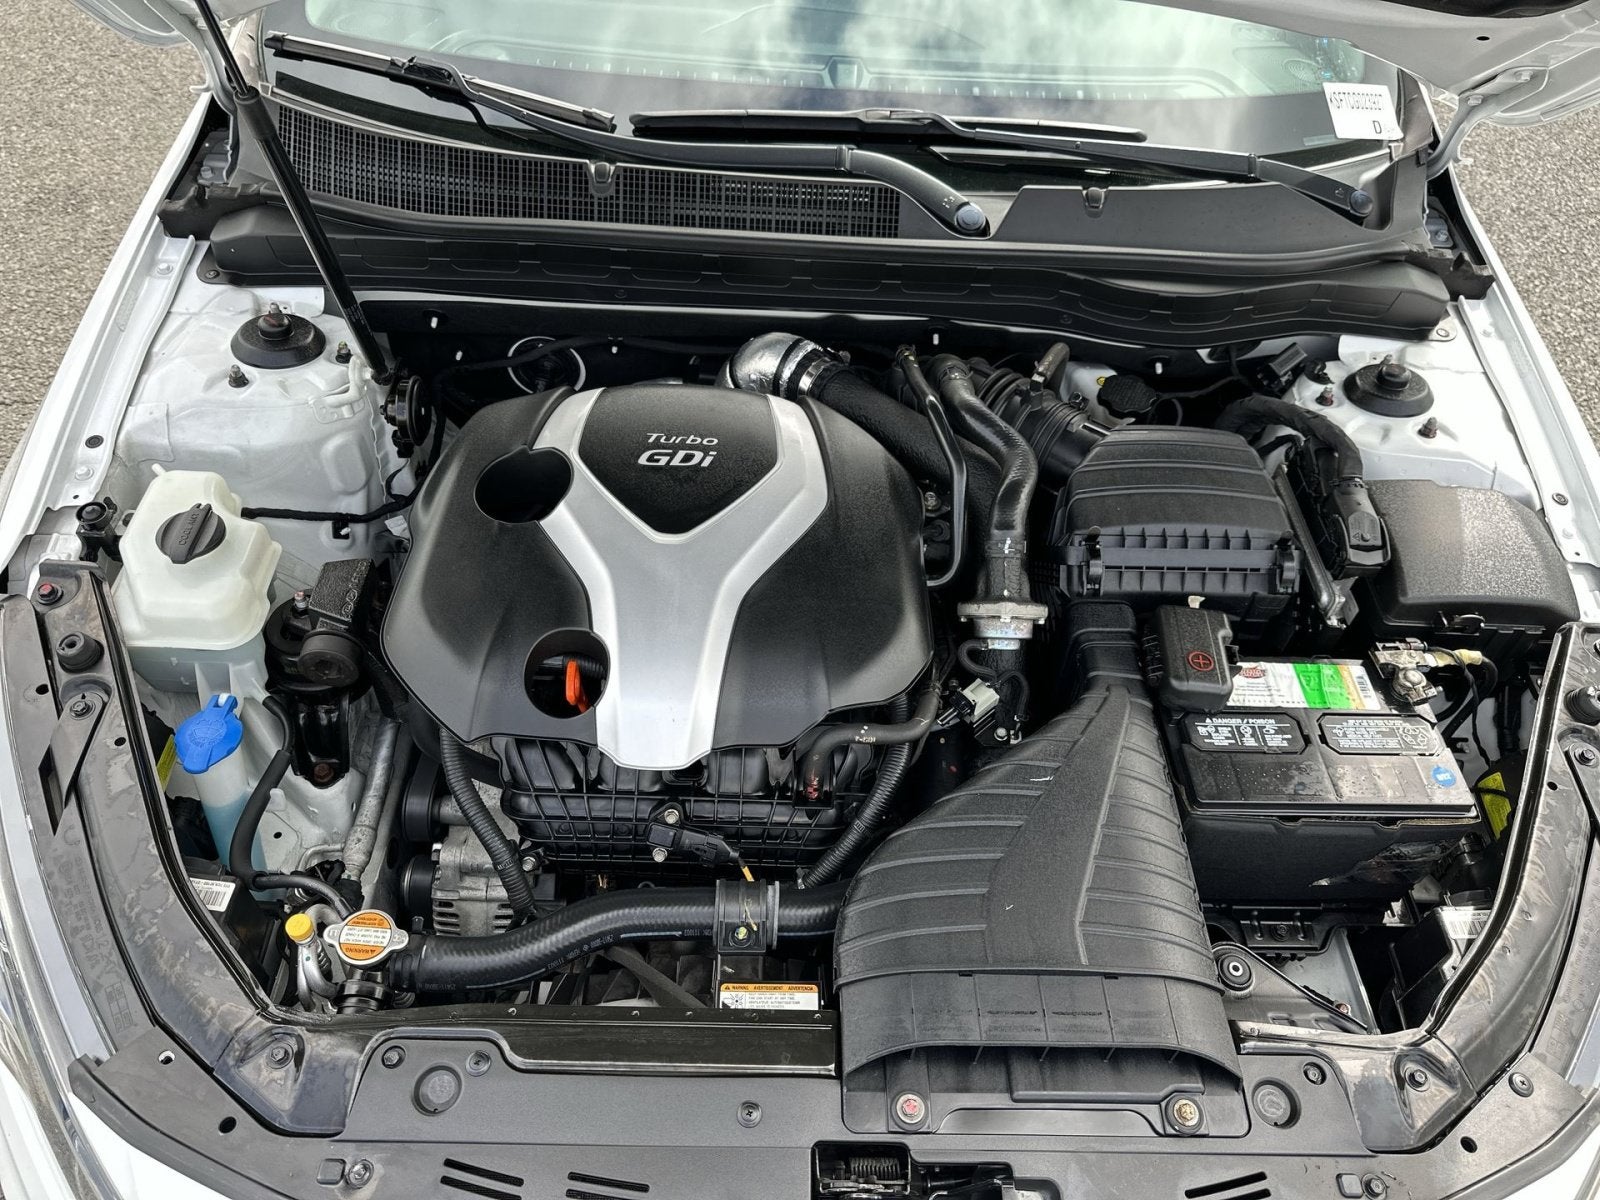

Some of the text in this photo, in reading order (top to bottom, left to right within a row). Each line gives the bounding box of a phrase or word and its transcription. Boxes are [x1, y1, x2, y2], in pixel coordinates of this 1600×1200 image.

[1372, 120, 1382, 134] D
[646, 432, 719, 446] Turbo
[637, 449, 717, 468] GDi
